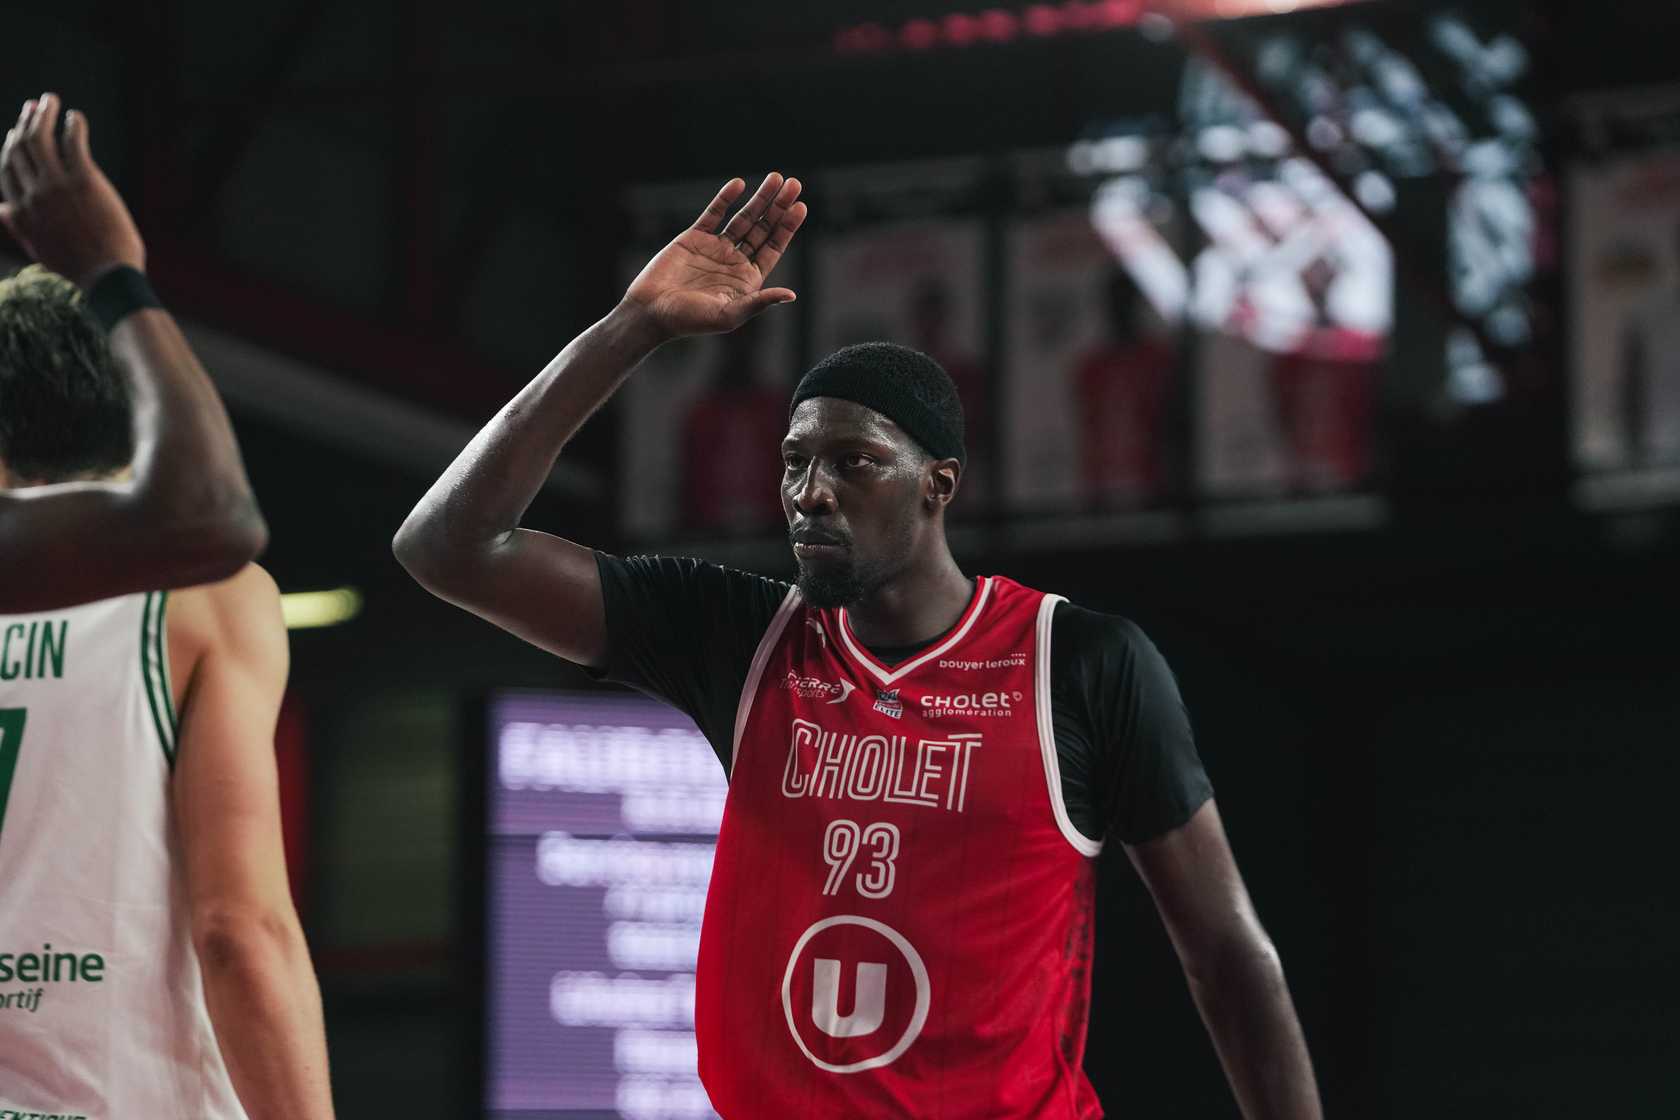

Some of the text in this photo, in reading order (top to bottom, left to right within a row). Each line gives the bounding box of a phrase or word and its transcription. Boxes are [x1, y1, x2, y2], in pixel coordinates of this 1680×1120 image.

[0, 620, 68, 680] CIN
[939, 659, 984, 671] bouyer
[921, 708, 1012, 718] agglomération
[781, 718, 983, 813] CHOLET
[822, 819, 901, 900] 93
[0, 943, 104, 982] seine
[811, 957, 888, 1038] U
